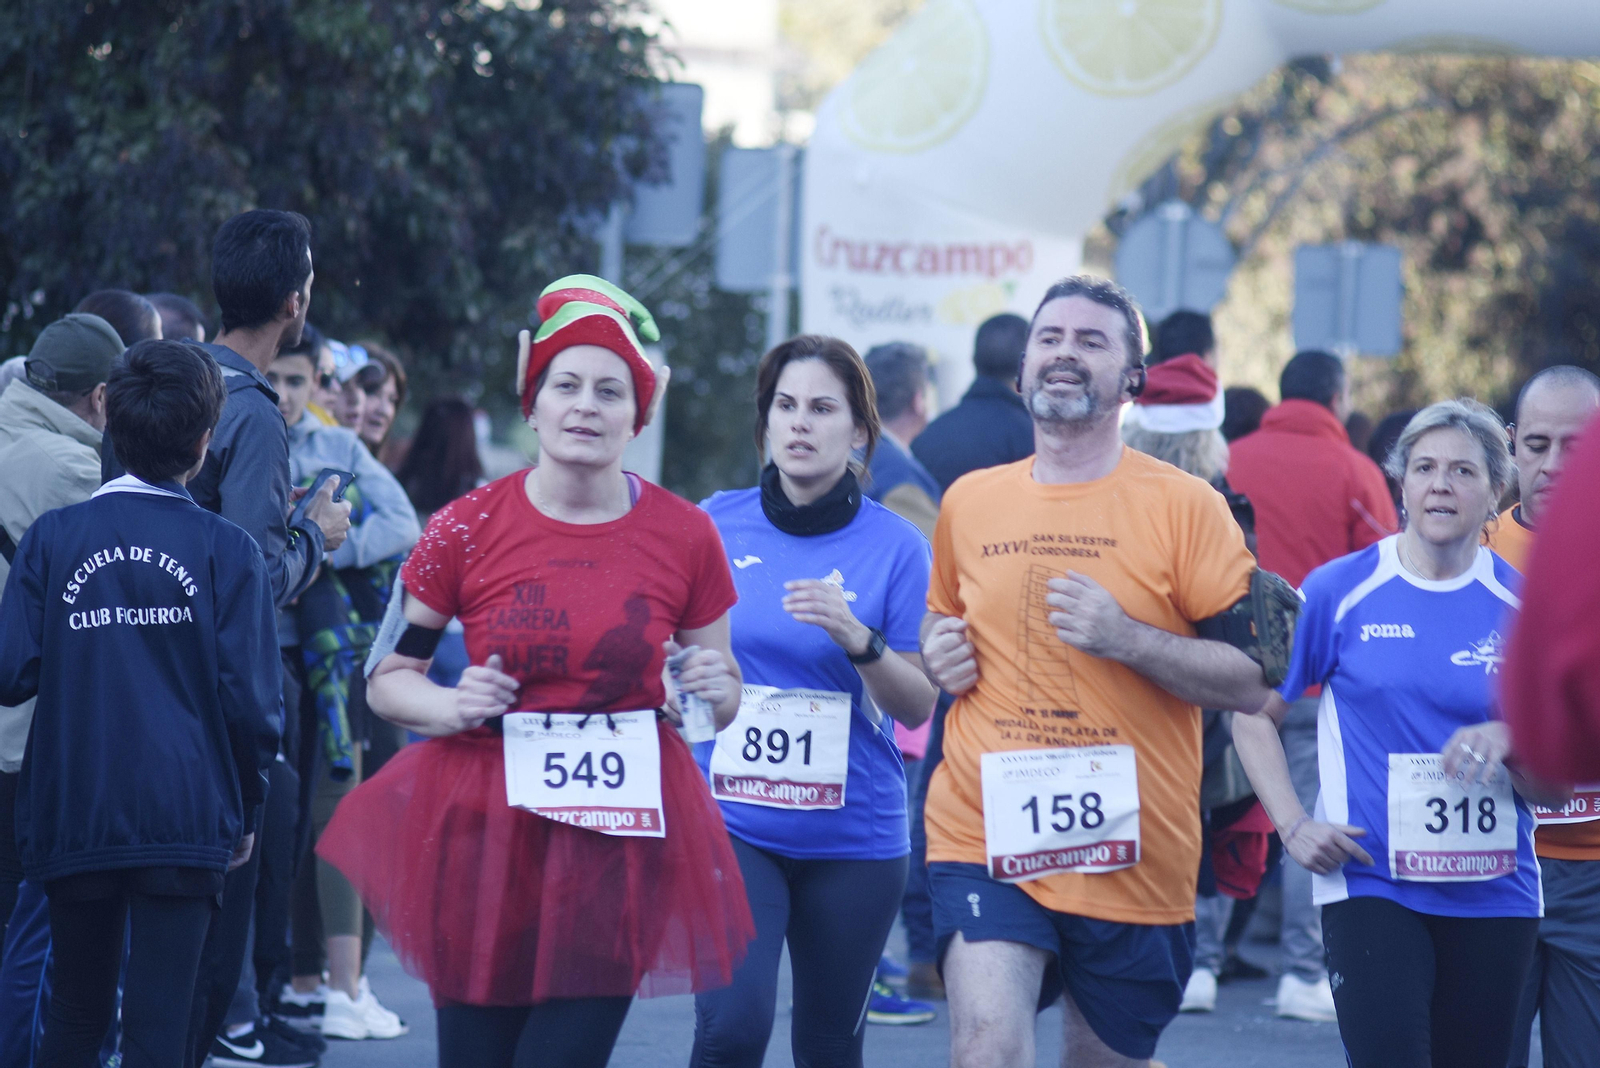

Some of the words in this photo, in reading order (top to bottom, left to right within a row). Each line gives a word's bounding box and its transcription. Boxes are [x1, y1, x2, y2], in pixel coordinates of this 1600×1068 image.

[814, 224, 1034, 278] Cruzcampo
[981, 540, 1028, 558] XXXVI
[1030, 546, 1101, 559] CORDOBESA
[1032, 534, 1055, 543] SAN
[1057, 534, 1118, 548] SILVESTRE
[62, 546, 125, 605] ESCUELA
[129, 546, 153, 563] DE
[158, 552, 198, 597] TENIS
[69, 608, 111, 630] CLUB
[115, 606, 193, 625] FIGUEROA
[487, 607, 570, 631] CARRERA
[1026, 733, 1041, 743] DE
[1043, 724, 1058, 733] DE
[1061, 727, 1099, 737] PLATA
[1102, 727, 1118, 737] DE
[742, 726, 812, 766] 891
[543, 751, 625, 789] 549
[722, 776, 820, 805] Cruzcampo
[530, 808, 636, 831] uzcampo
[1021, 791, 1105, 834] 158
[1425, 796, 1497, 834] 318
[1002, 845, 1111, 876] Cruzcampo
[1405, 851, 1498, 875] Cruzcampo
